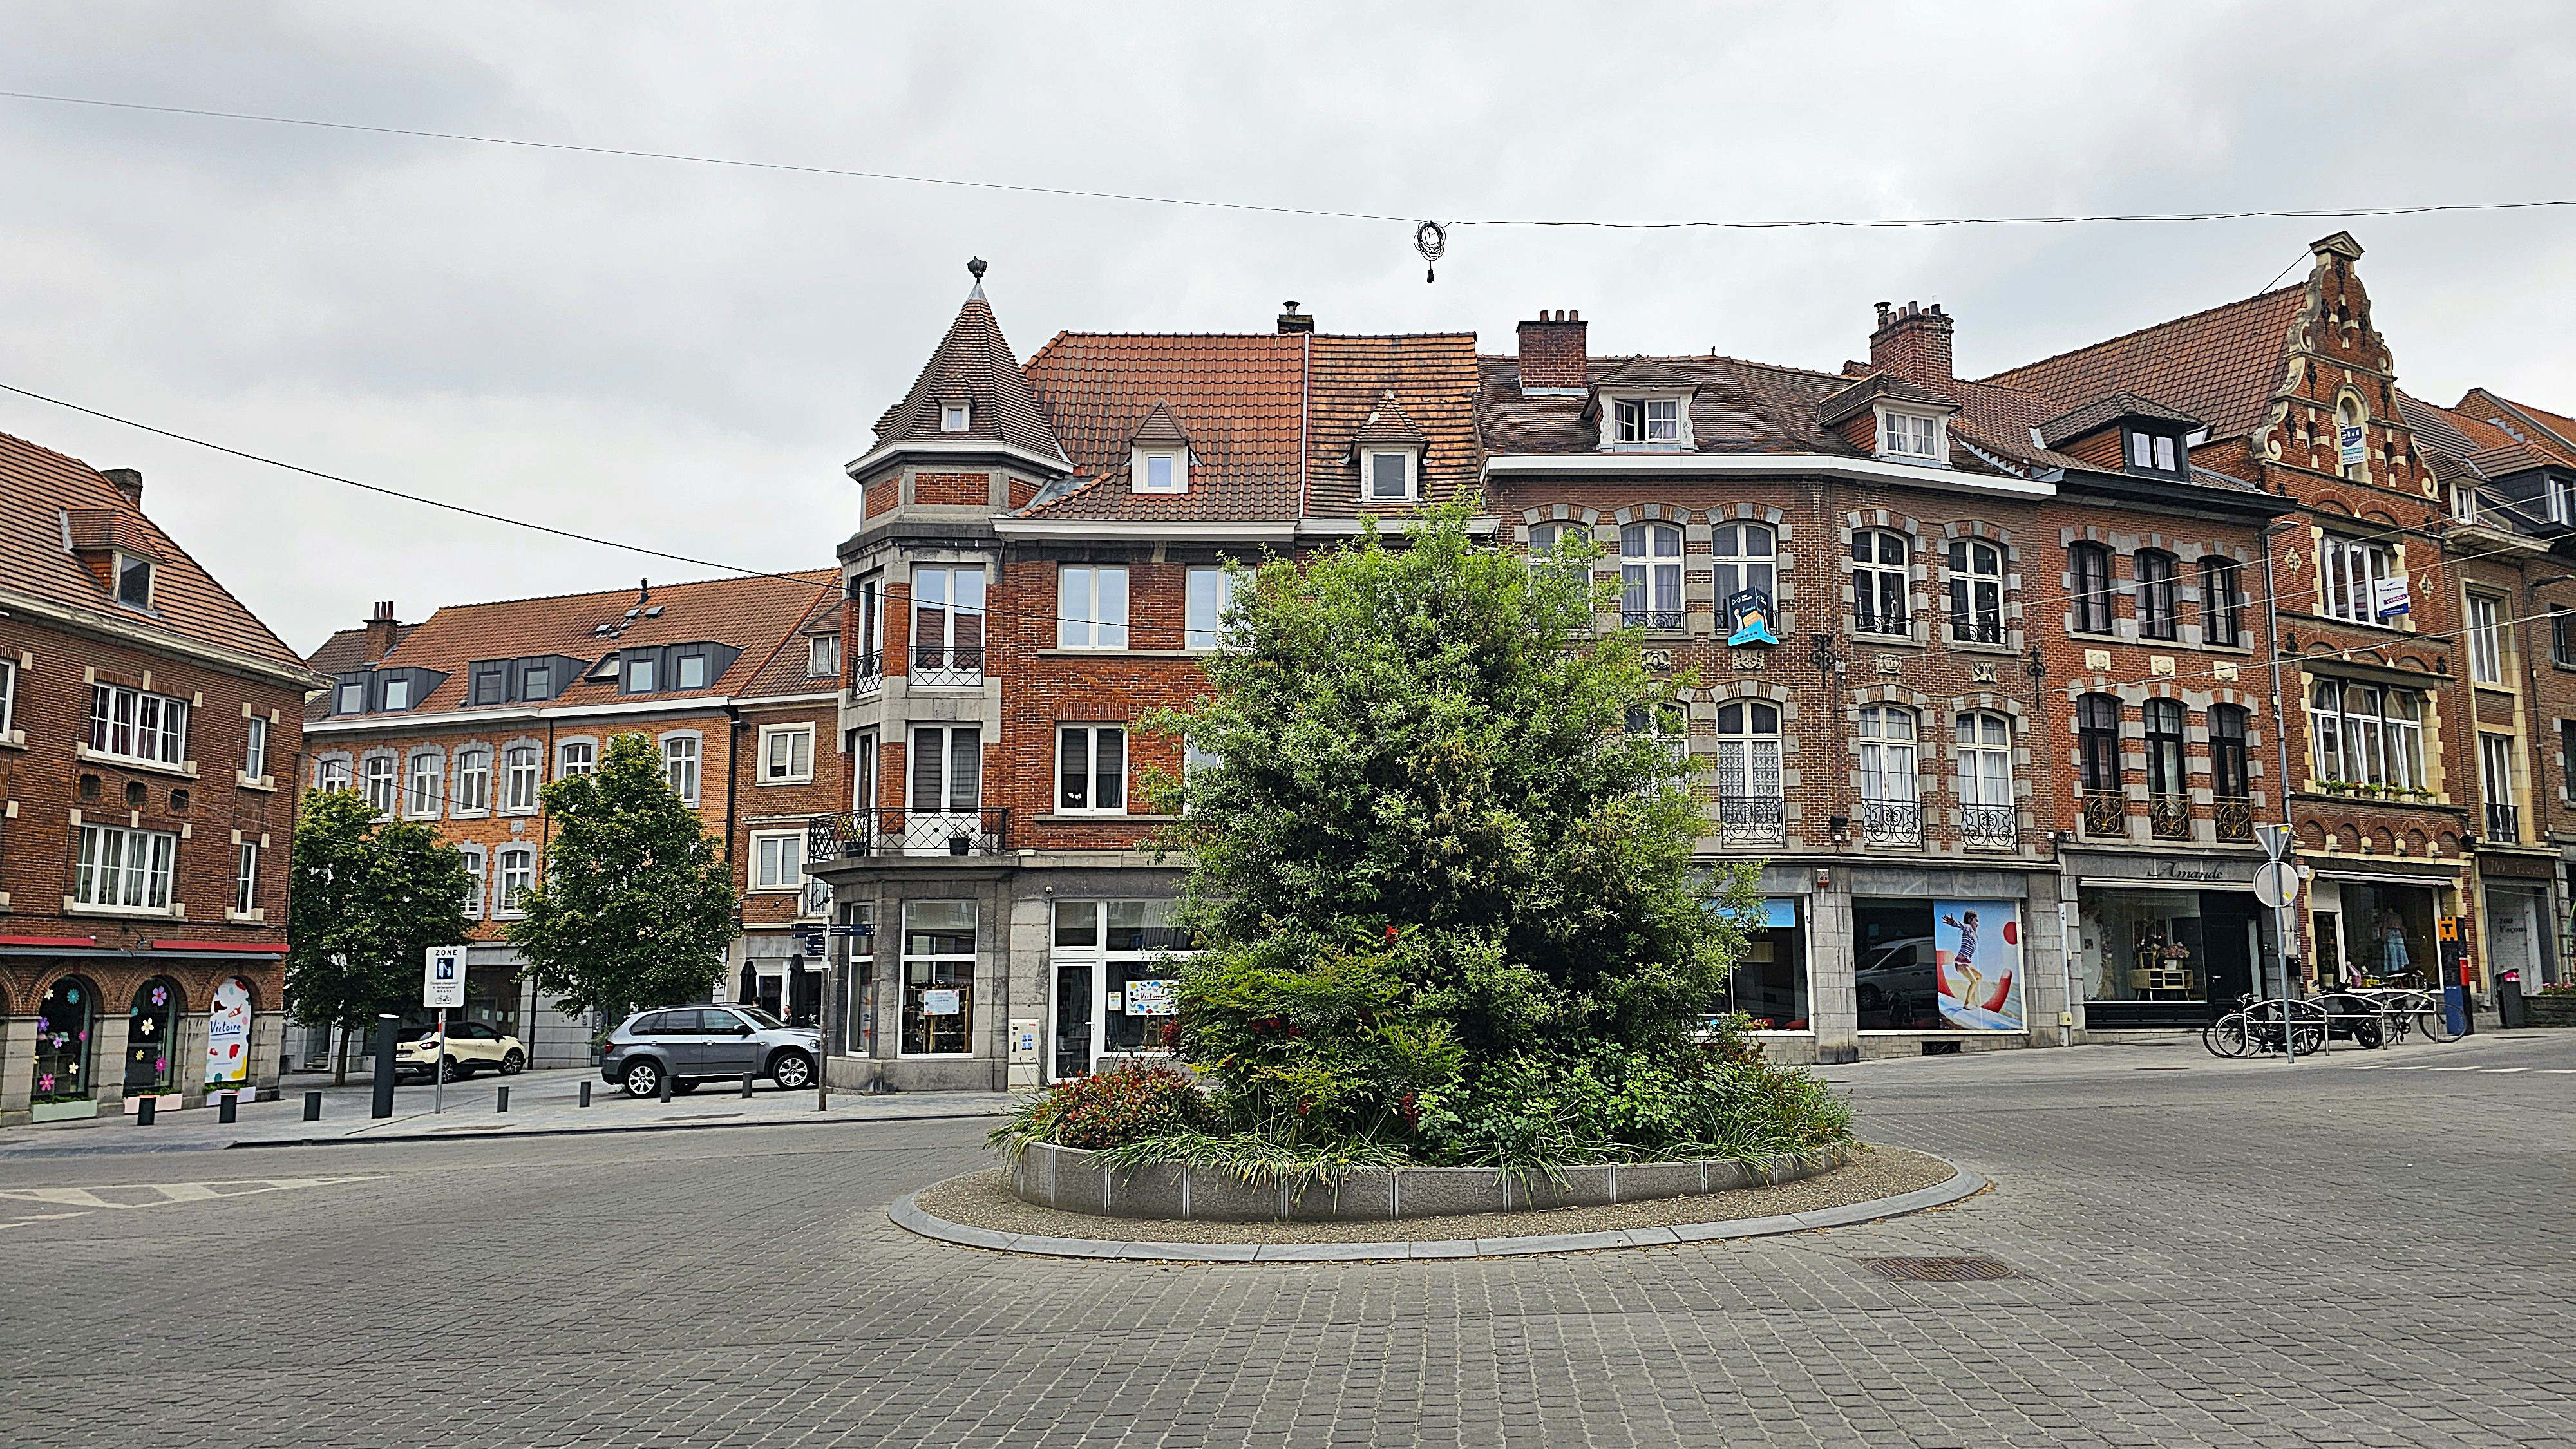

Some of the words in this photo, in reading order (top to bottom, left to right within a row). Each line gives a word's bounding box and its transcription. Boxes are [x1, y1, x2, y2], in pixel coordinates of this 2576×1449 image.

[2385, 594, 2405, 603] VENDU
[2147, 861, 2226, 879] Amande
[210, 1020, 242, 1033] Victoire
